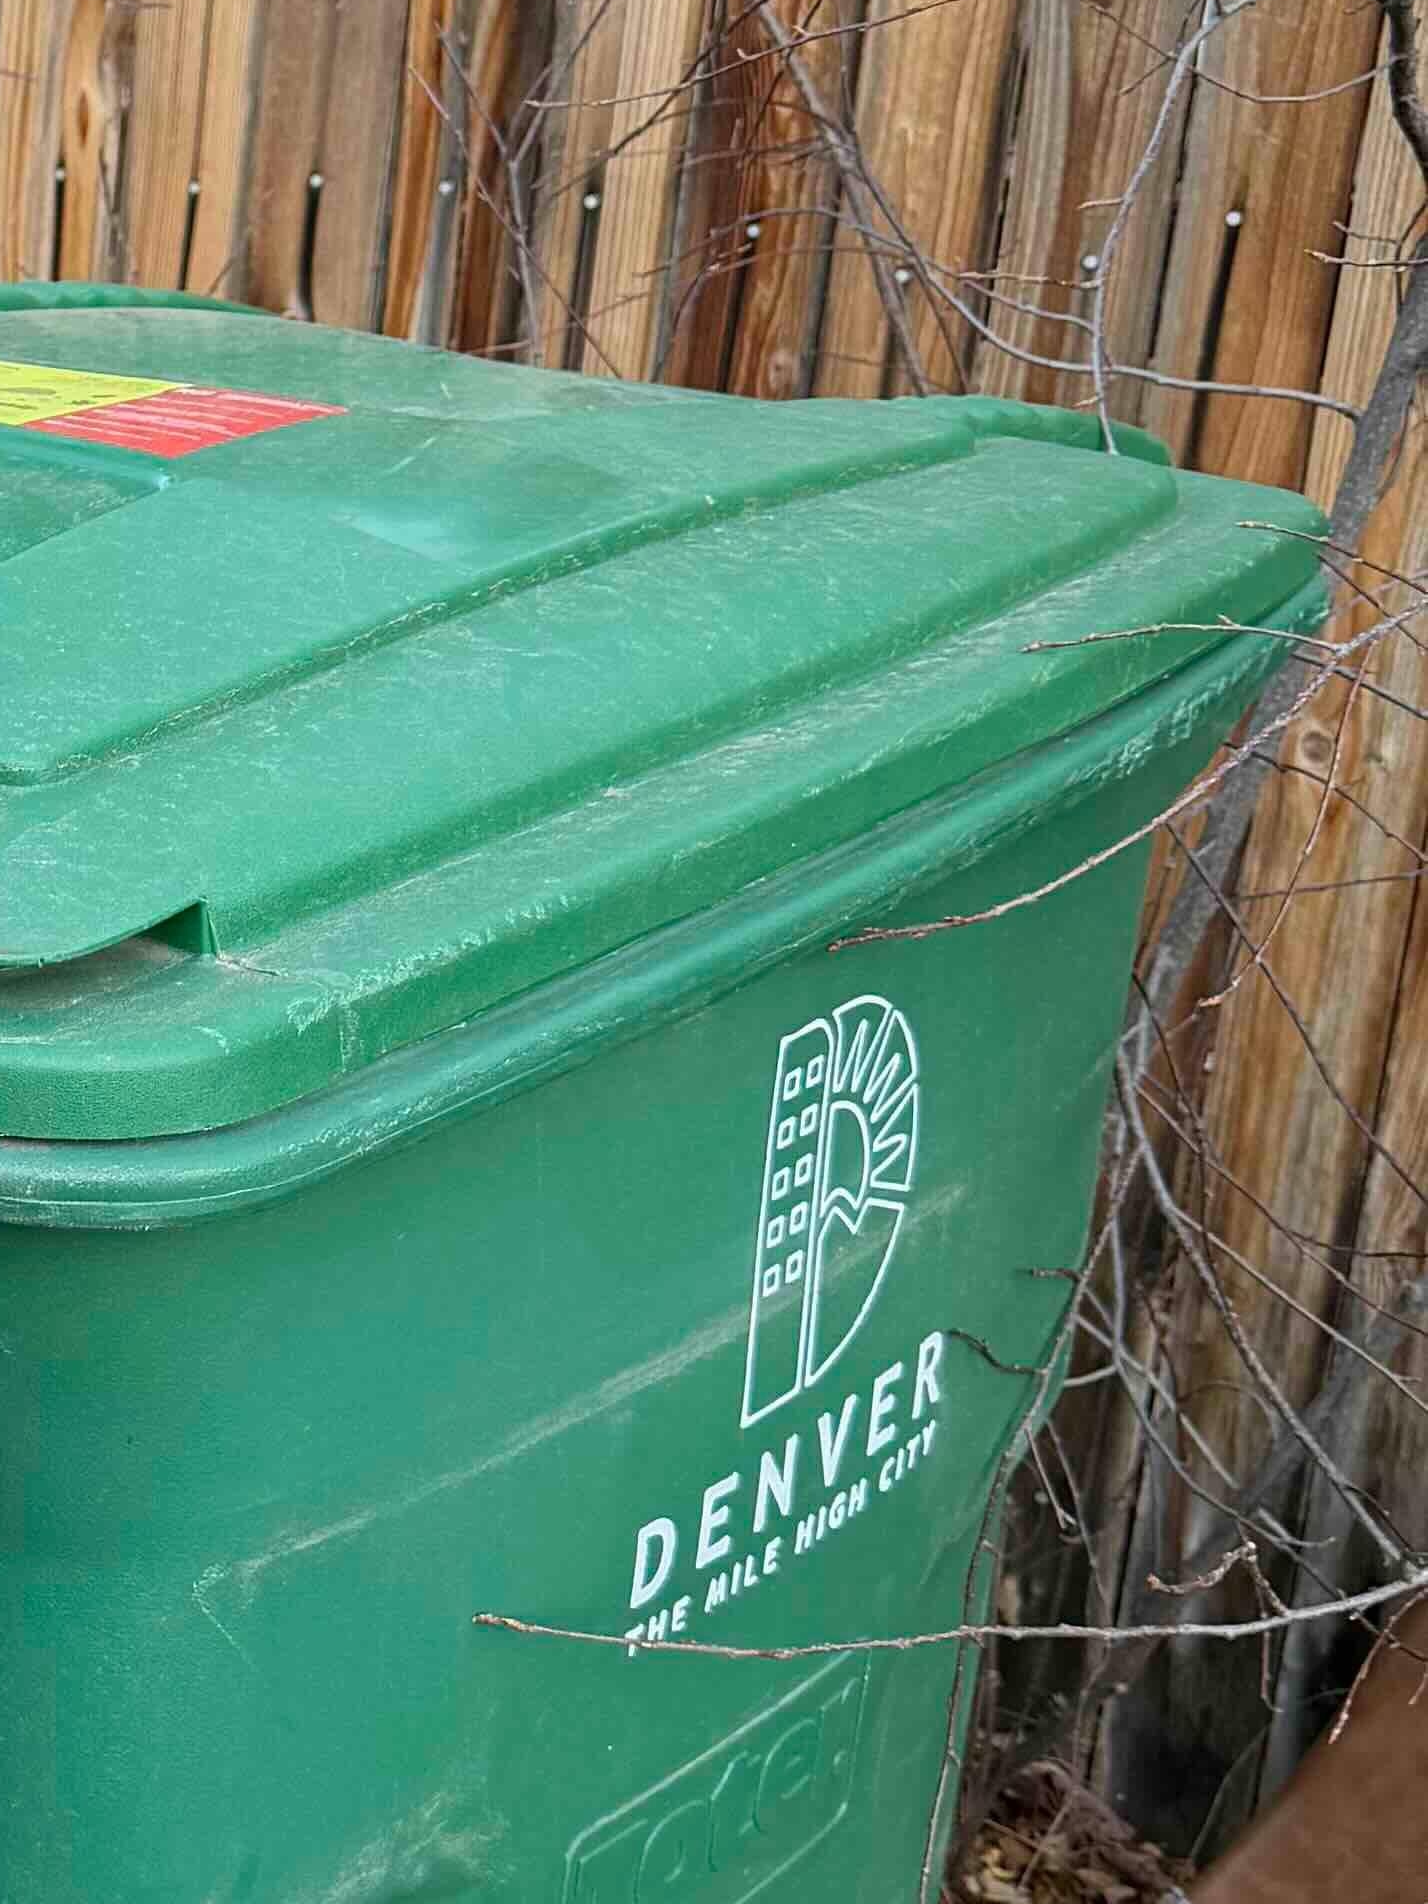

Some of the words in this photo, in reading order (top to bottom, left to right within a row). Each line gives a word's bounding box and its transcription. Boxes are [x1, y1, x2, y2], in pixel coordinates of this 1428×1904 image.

[625, 1595, 692, 1657] THE
[704, 1536, 783, 1614] MILE
[794, 1477, 868, 1555] HIGH
[878, 1418, 937, 1493] CITY
[629, 1331, 943, 1609] DENVER
